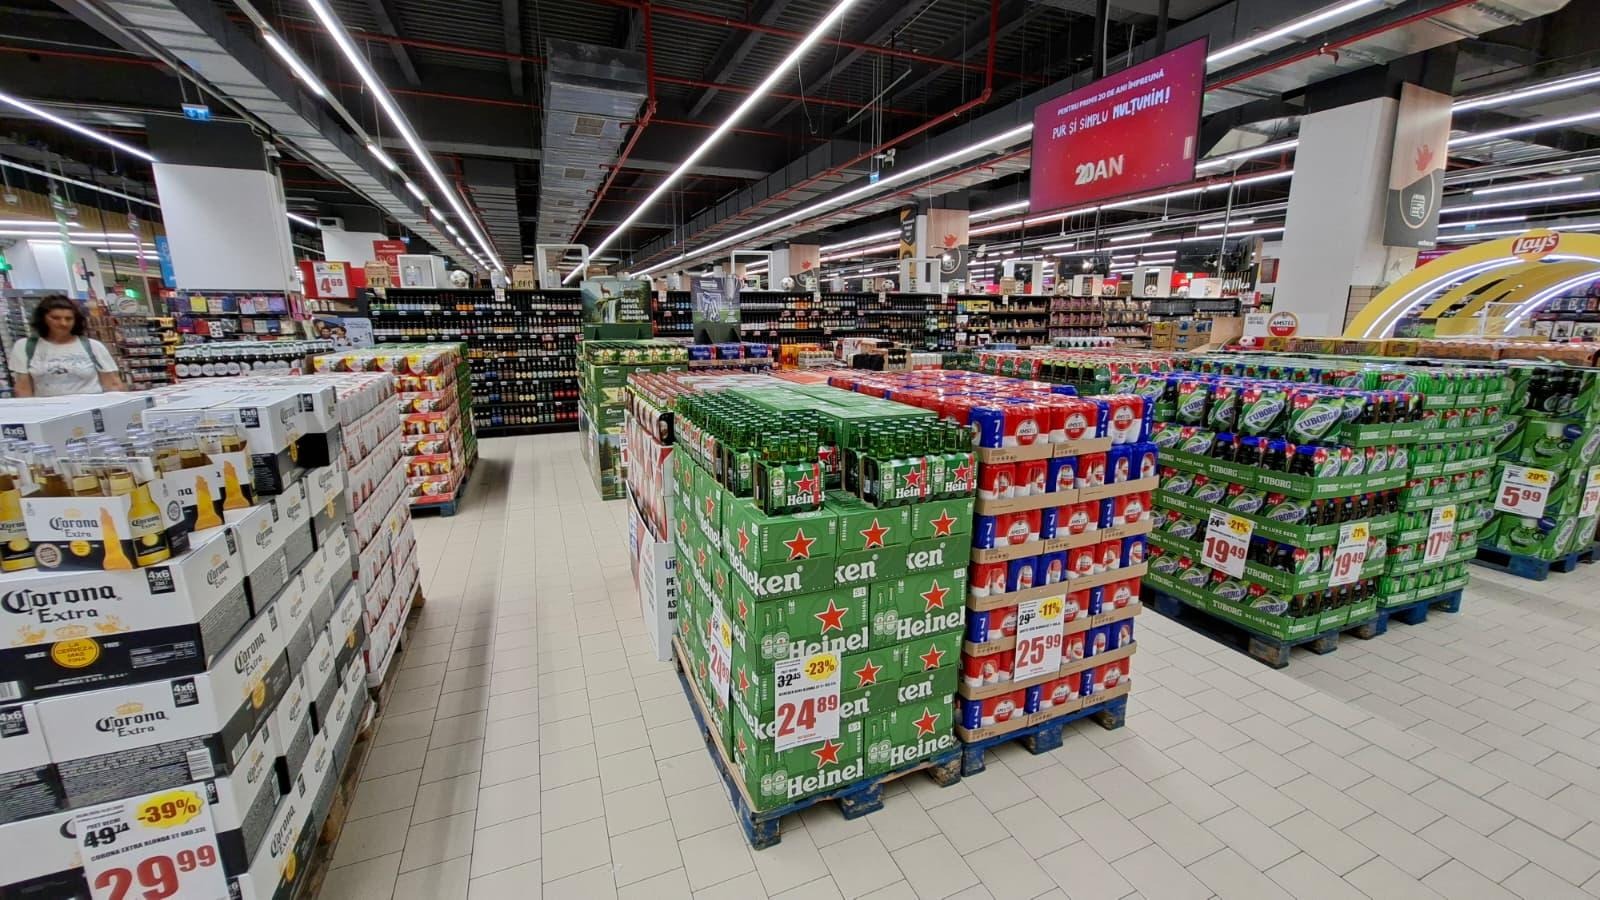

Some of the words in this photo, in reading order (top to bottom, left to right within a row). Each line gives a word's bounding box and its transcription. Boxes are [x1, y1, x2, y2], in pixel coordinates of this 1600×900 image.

[1052, 124, 1066, 140] PUR
[1248, 402, 1280, 422] TUBORG
[1298, 407, 1337, 428] TUBORG
[3, 428, 25, 436] 4x6
[1210, 464, 1238, 477] TUBORG
[1258, 475, 1292, 489] TUBORG
[1502, 486, 1520, 507] 5
[1521, 490, 1542, 502] 99
[50, 516, 99, 531] Corona
[131, 515, 160, 528] Corona
[65, 530, 92, 538] Extra
[1206, 537, 1230, 563] 19
[1230, 545, 1246, 560] 49
[206, 560, 229, 586] Corona
[1335, 552, 1351, 577] 19
[148, 570, 170, 580] 4x6
[1, 585, 116, 615] Corona
[1213, 600, 1242, 616] TUBORG
[38, 607, 98, 624] Extra
[234, 632, 265, 674] Corona
[1016, 636, 1044, 668] 25
[1046, 634, 1061, 649] 99
[805, 659, 835, 675] -23%
[172, 683, 194, 693] 4x6
[96, 710, 168, 733] Corona
[777, 698, 816, 737] 24
[817, 694, 838, 713] 89
[118, 726, 155, 738] Extra
[890, 734, 955, 766] Heine
[137, 797, 197, 823] -39%
[84, 827, 117, 848] 49
[271, 804, 296, 859] Corona
[91, 849, 120, 862] CORONA
[94, 855, 180, 900] 29
[176, 844, 217, 873] 99
